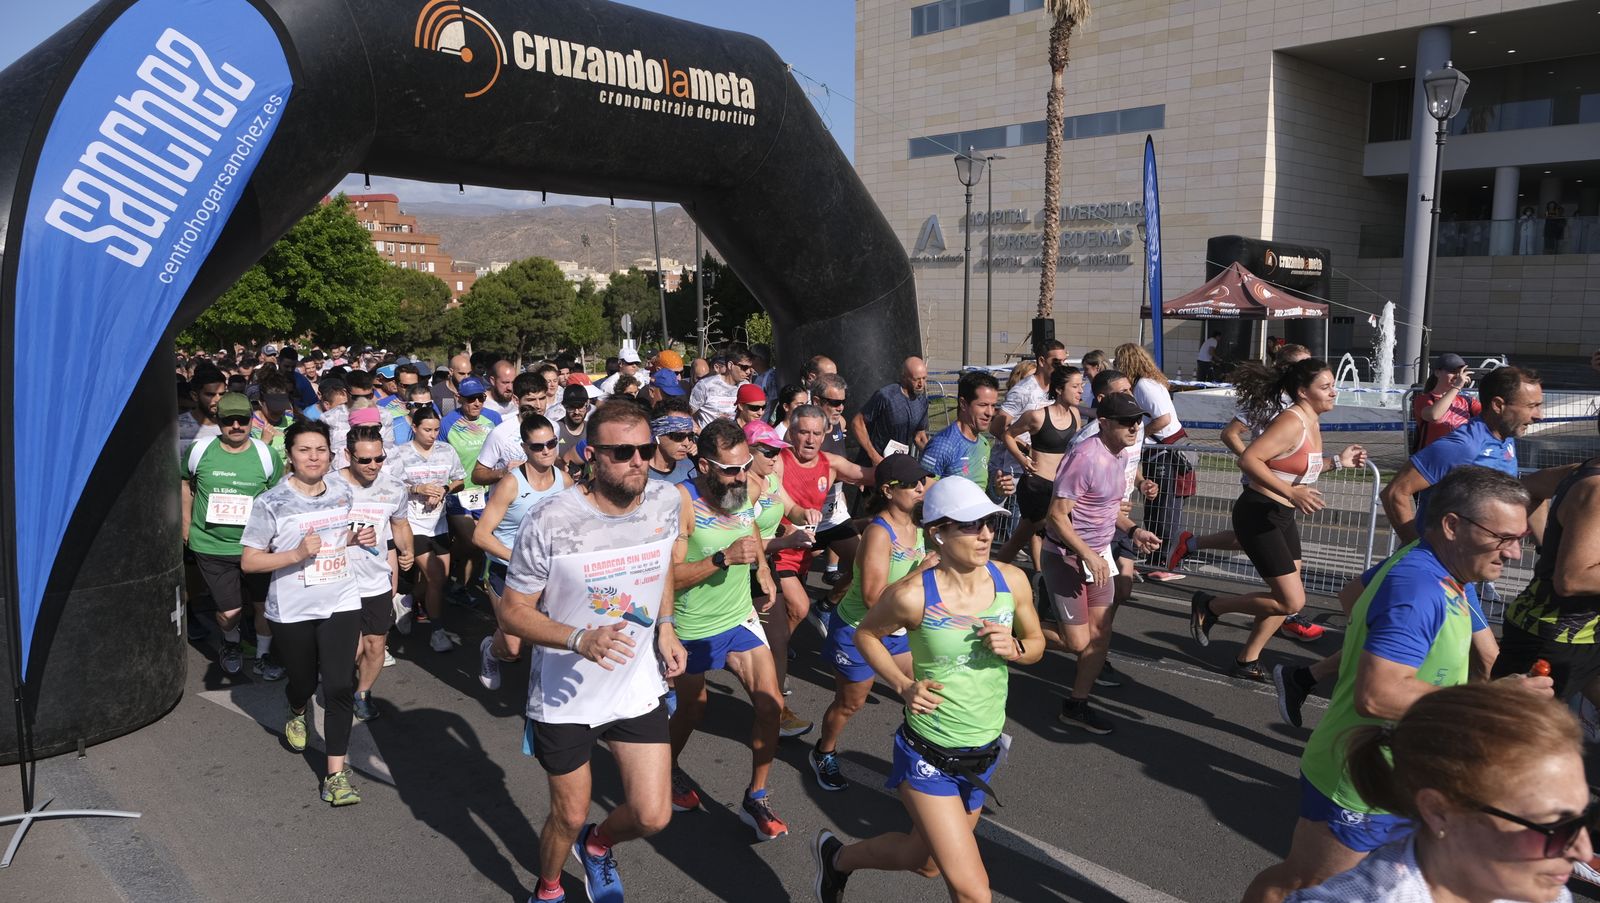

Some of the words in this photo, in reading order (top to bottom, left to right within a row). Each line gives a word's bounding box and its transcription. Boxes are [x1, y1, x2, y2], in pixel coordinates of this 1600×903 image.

[600, 89, 693, 117] cronometraje
[697, 104, 755, 126] deportivo
[159, 94, 283, 284] centrohogarsanchez.es
[469, 494, 479, 503] 25
[213, 504, 246, 514] 1211
[315, 556, 346, 572] 1064
[592, 558, 626, 572] CARRERA
[627, 553, 640, 565] SIN
[642, 550, 661, 561] HUMO
[642, 575, 660, 585] JUNIO
